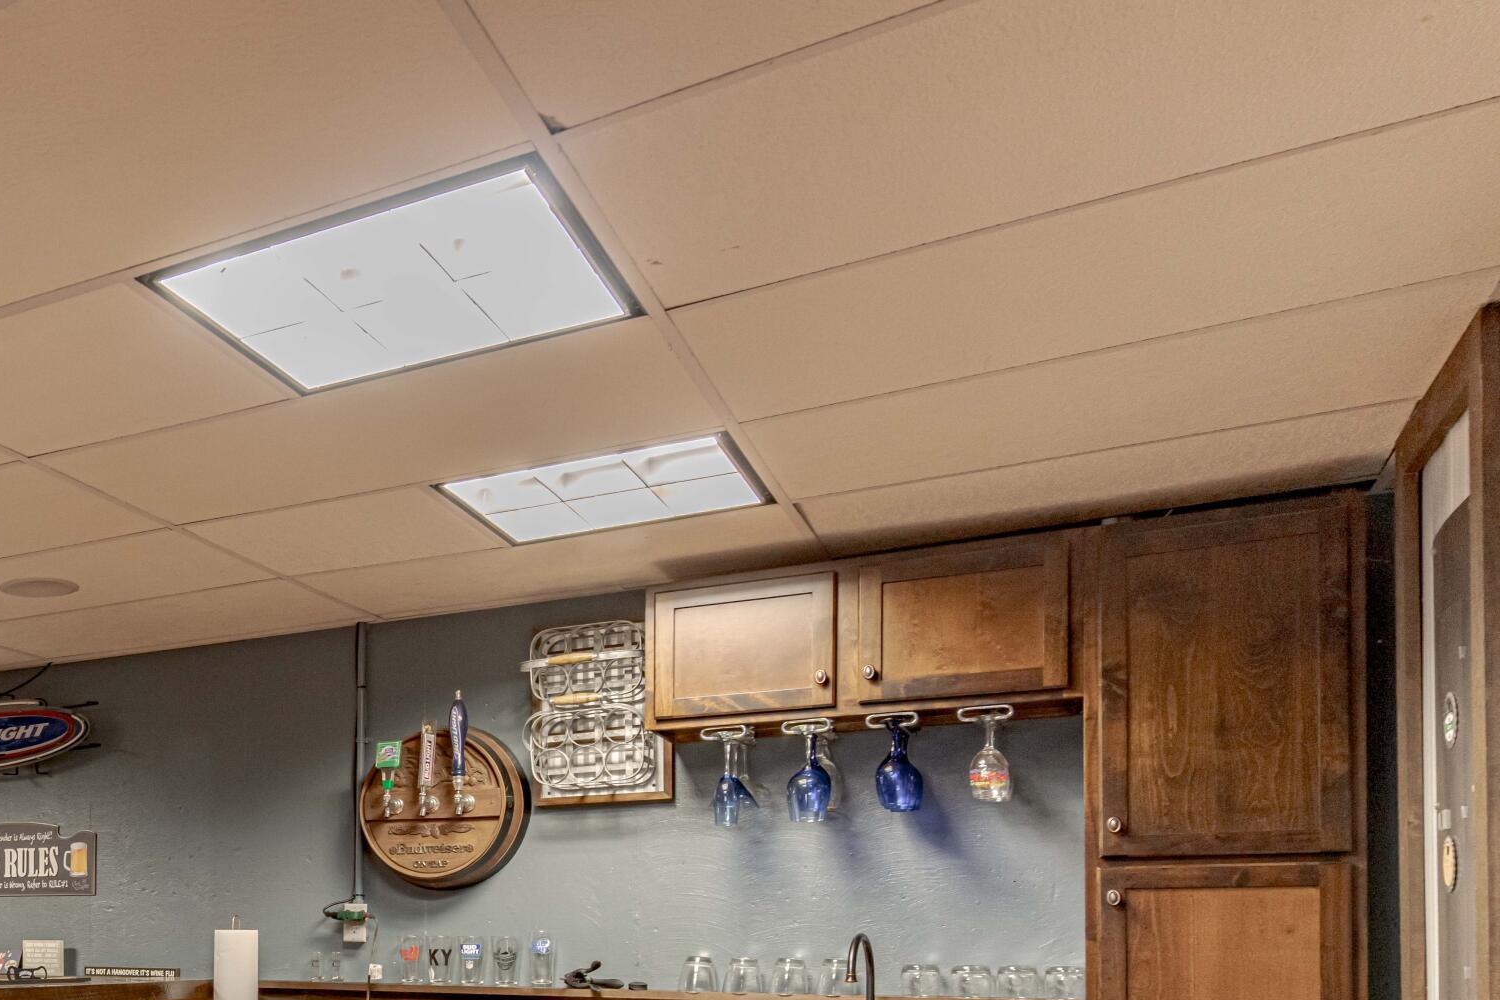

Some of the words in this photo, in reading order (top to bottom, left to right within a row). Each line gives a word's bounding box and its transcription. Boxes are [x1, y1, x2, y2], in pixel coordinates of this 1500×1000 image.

[395, 843, 467, 855] Budweiser
[3, 846, 59, 878] RULES
[428, 949, 452, 966] KY
